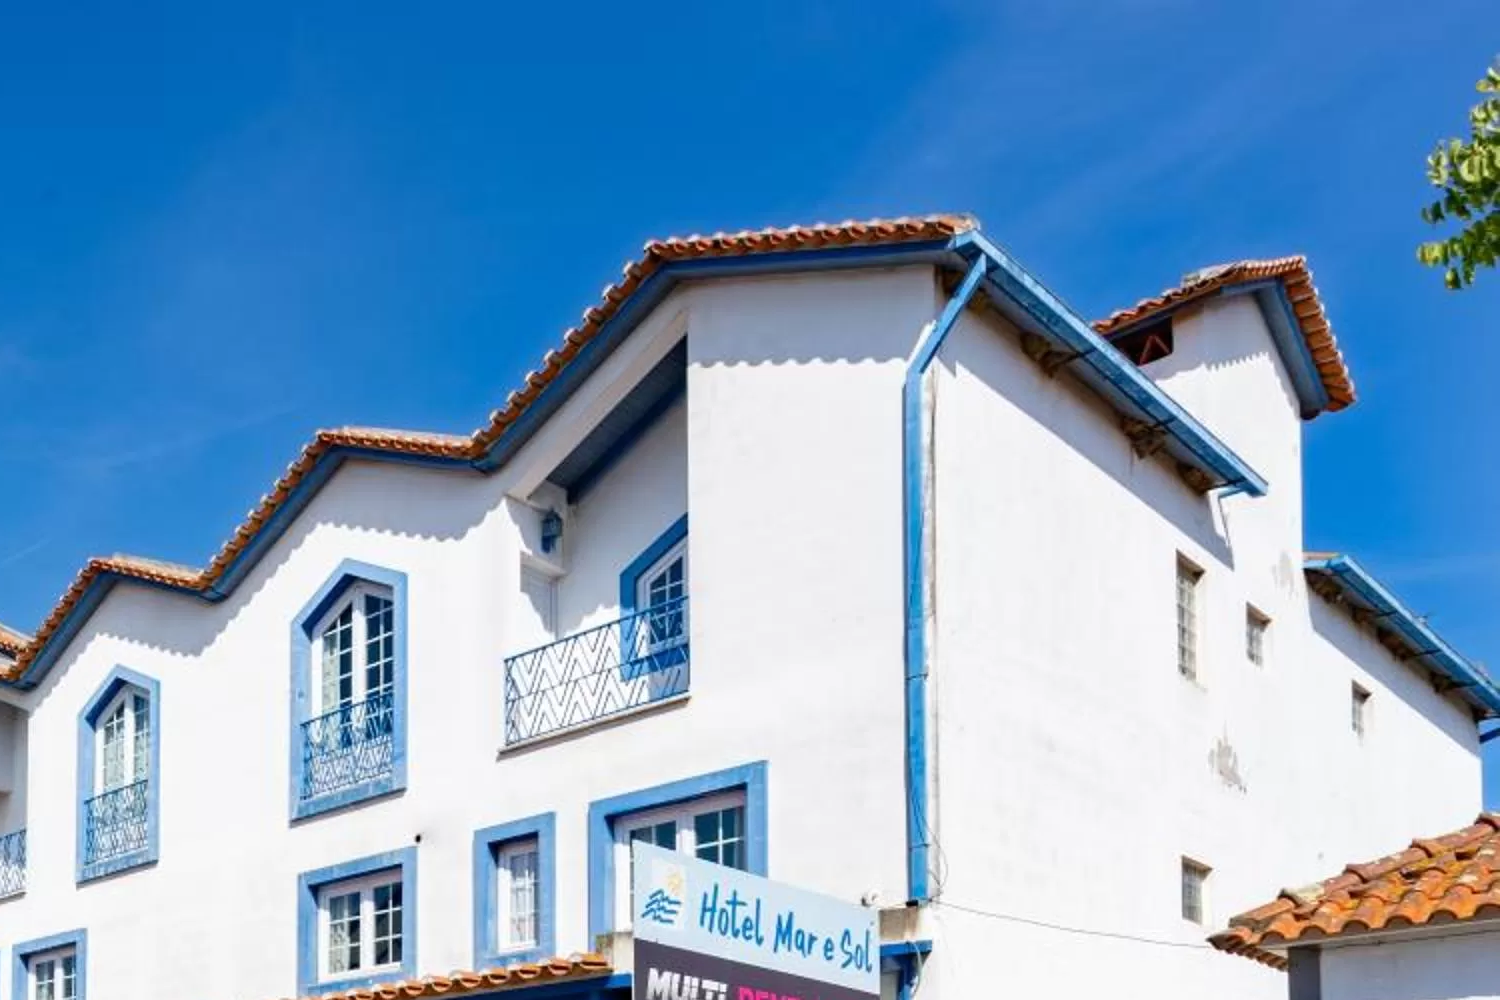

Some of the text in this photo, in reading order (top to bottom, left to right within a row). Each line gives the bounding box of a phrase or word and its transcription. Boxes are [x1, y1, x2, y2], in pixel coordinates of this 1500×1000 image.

[700, 883, 873, 973] Hotel Mar e Sol
